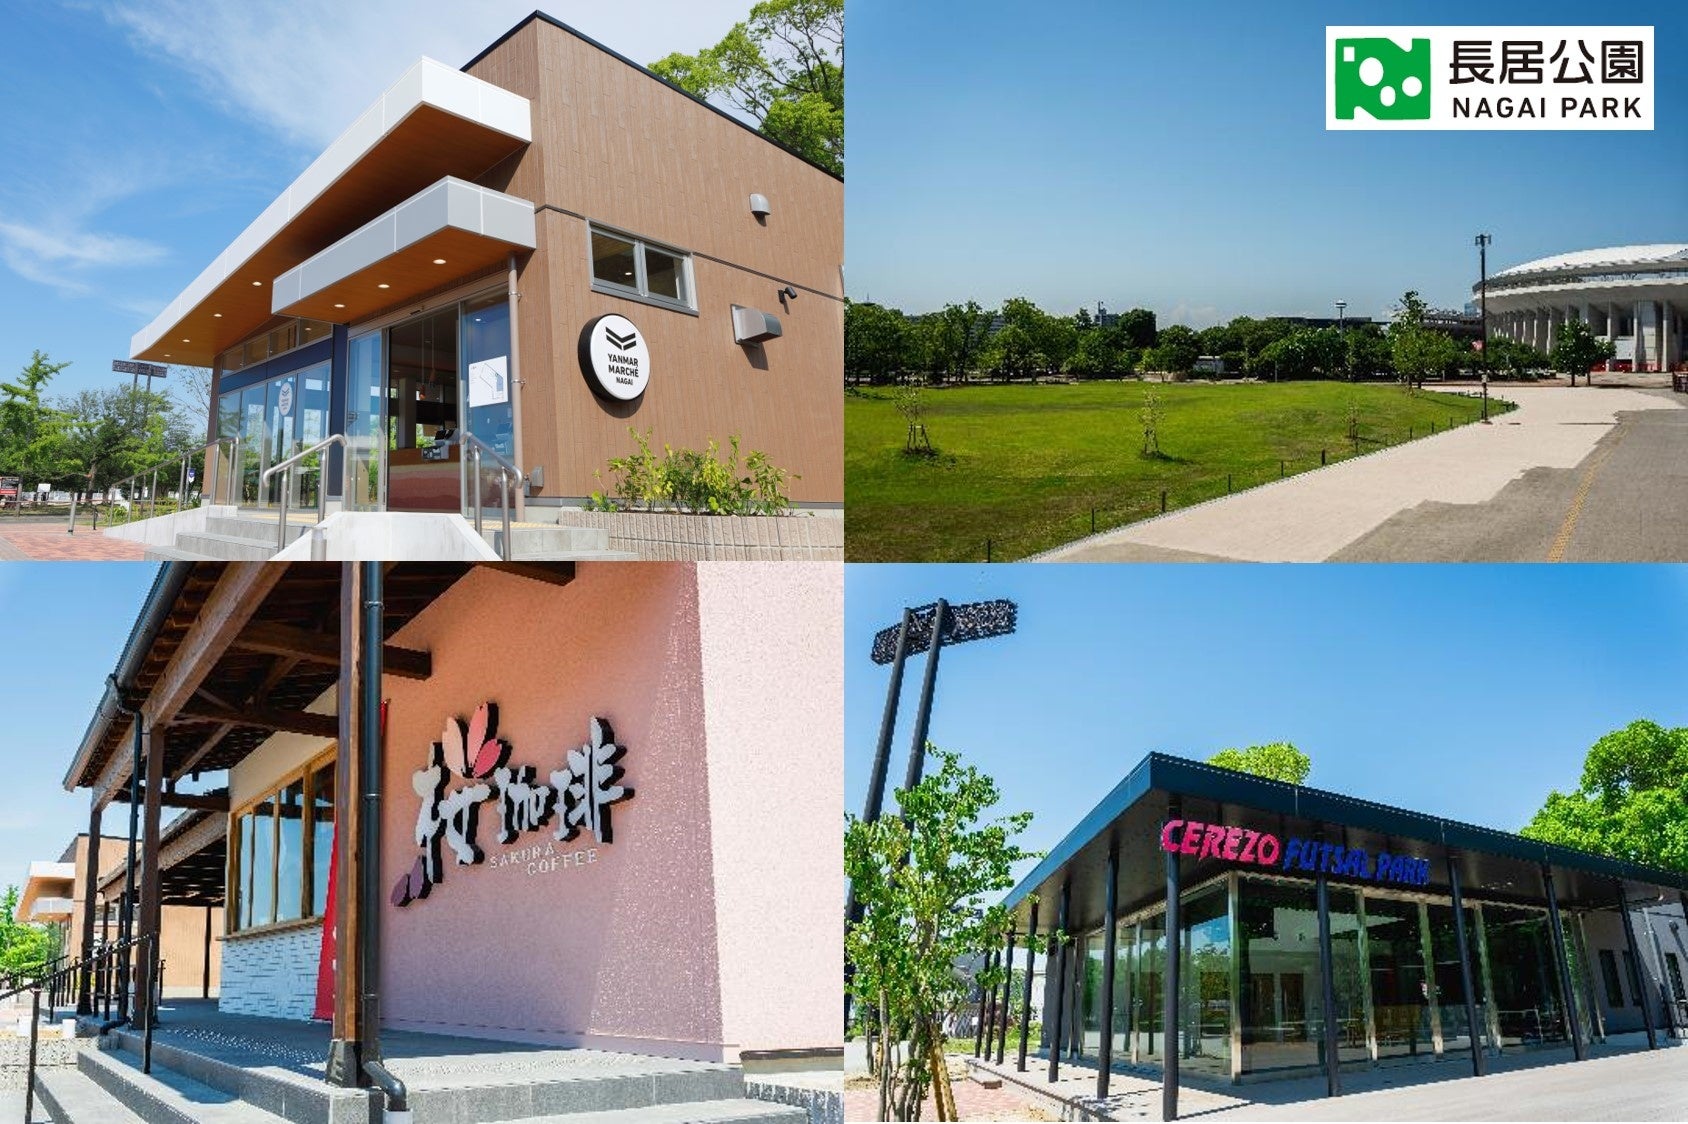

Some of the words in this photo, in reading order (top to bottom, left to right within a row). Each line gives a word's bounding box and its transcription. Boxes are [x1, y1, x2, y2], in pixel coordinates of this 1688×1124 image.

[608, 353, 639, 367] YANMAR
[608, 364, 639, 378] MARCHÉ
[616, 376, 634, 386] NAGAI
[490, 842, 555, 869] SAKURA
[527, 848, 598, 876] COFFEE
[1160, 819, 1280, 866] CEREZO
[1283, 836, 1375, 879] FUTSAL
[1376, 852, 1432, 886] PARK
